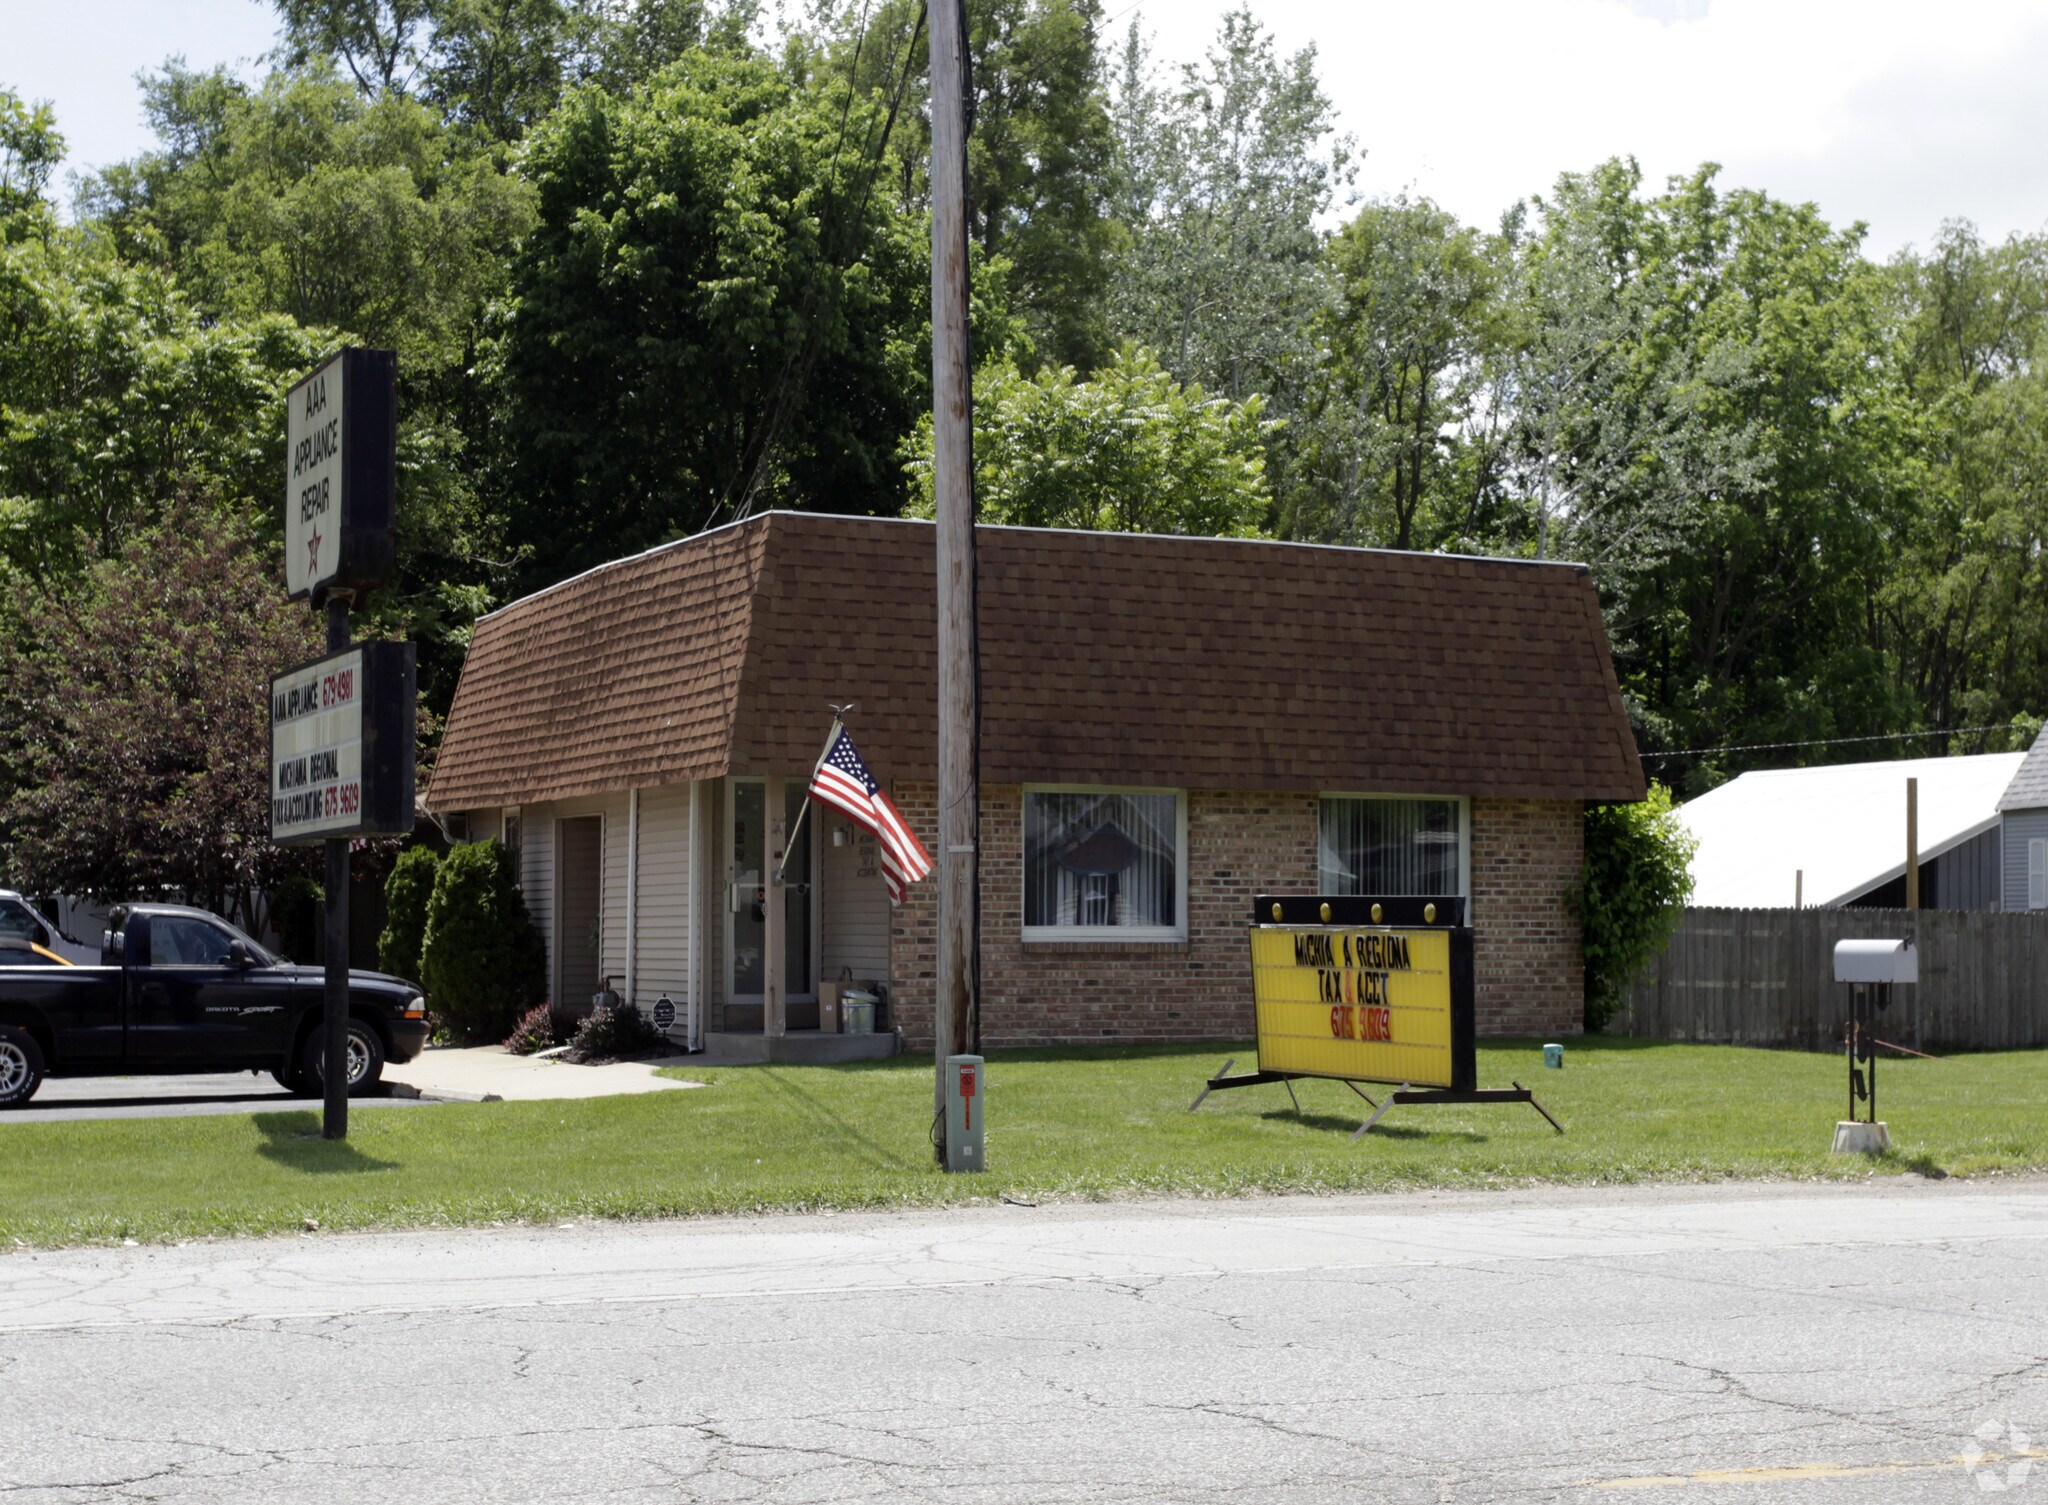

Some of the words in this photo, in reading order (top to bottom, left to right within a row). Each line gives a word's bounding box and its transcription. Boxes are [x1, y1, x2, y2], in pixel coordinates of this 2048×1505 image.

[305, 375, 327, 421] AAA
[293, 418, 338, 479] APPLIANCE
[301, 477, 330, 525] REPAIR
[274, 693, 287, 722] AAA
[288, 682, 318, 718] APPLIANCE
[279, 757, 307, 790] MICHIANA
[310, 749, 339, 783] REGIONAL
[325, 786, 338, 817] 675
[340, 782, 359, 815] 9609
[1318, 969, 1342, 1002] TAX
[1357, 970, 1389, 1005] ACCT
[1331, 1006, 1355, 1039] 675
